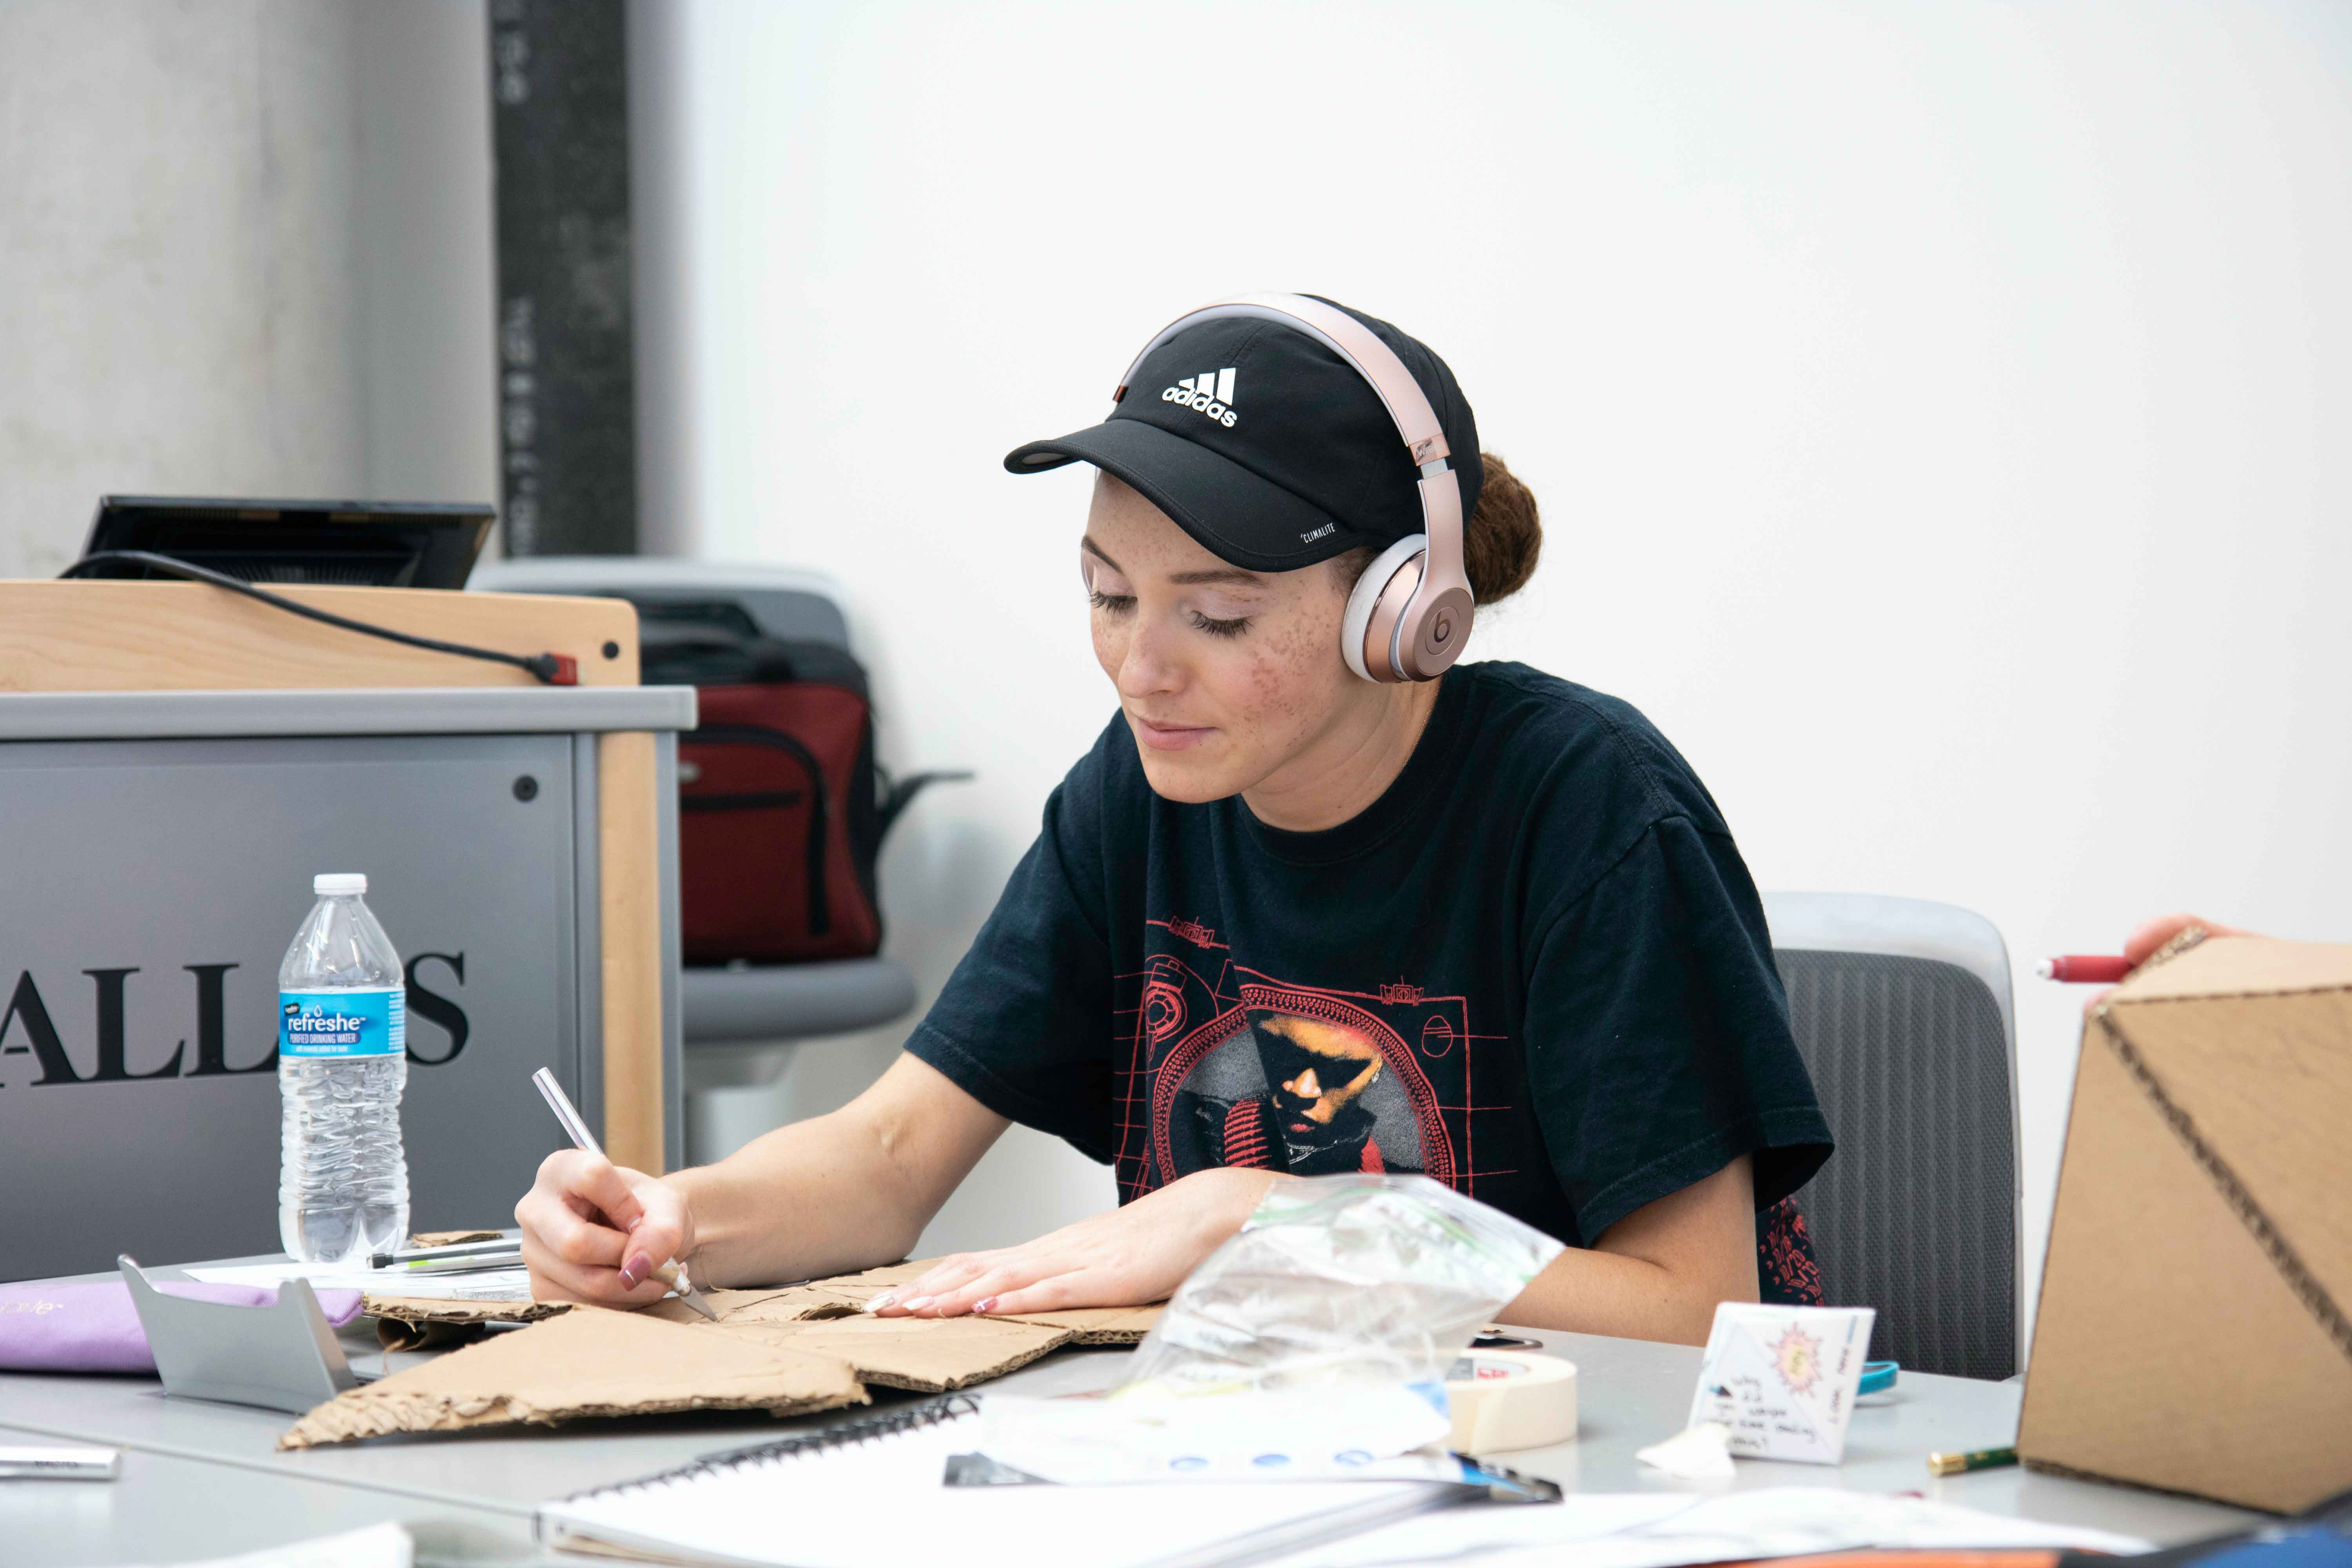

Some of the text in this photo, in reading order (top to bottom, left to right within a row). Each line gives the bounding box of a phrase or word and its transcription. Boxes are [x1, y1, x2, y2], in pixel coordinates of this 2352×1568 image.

[1162, 387, 1238, 428] adidas
[0, 952, 468, 1088] ALLS
[289, 1033, 356, 1044] PURIFIED DRINKING WATER
